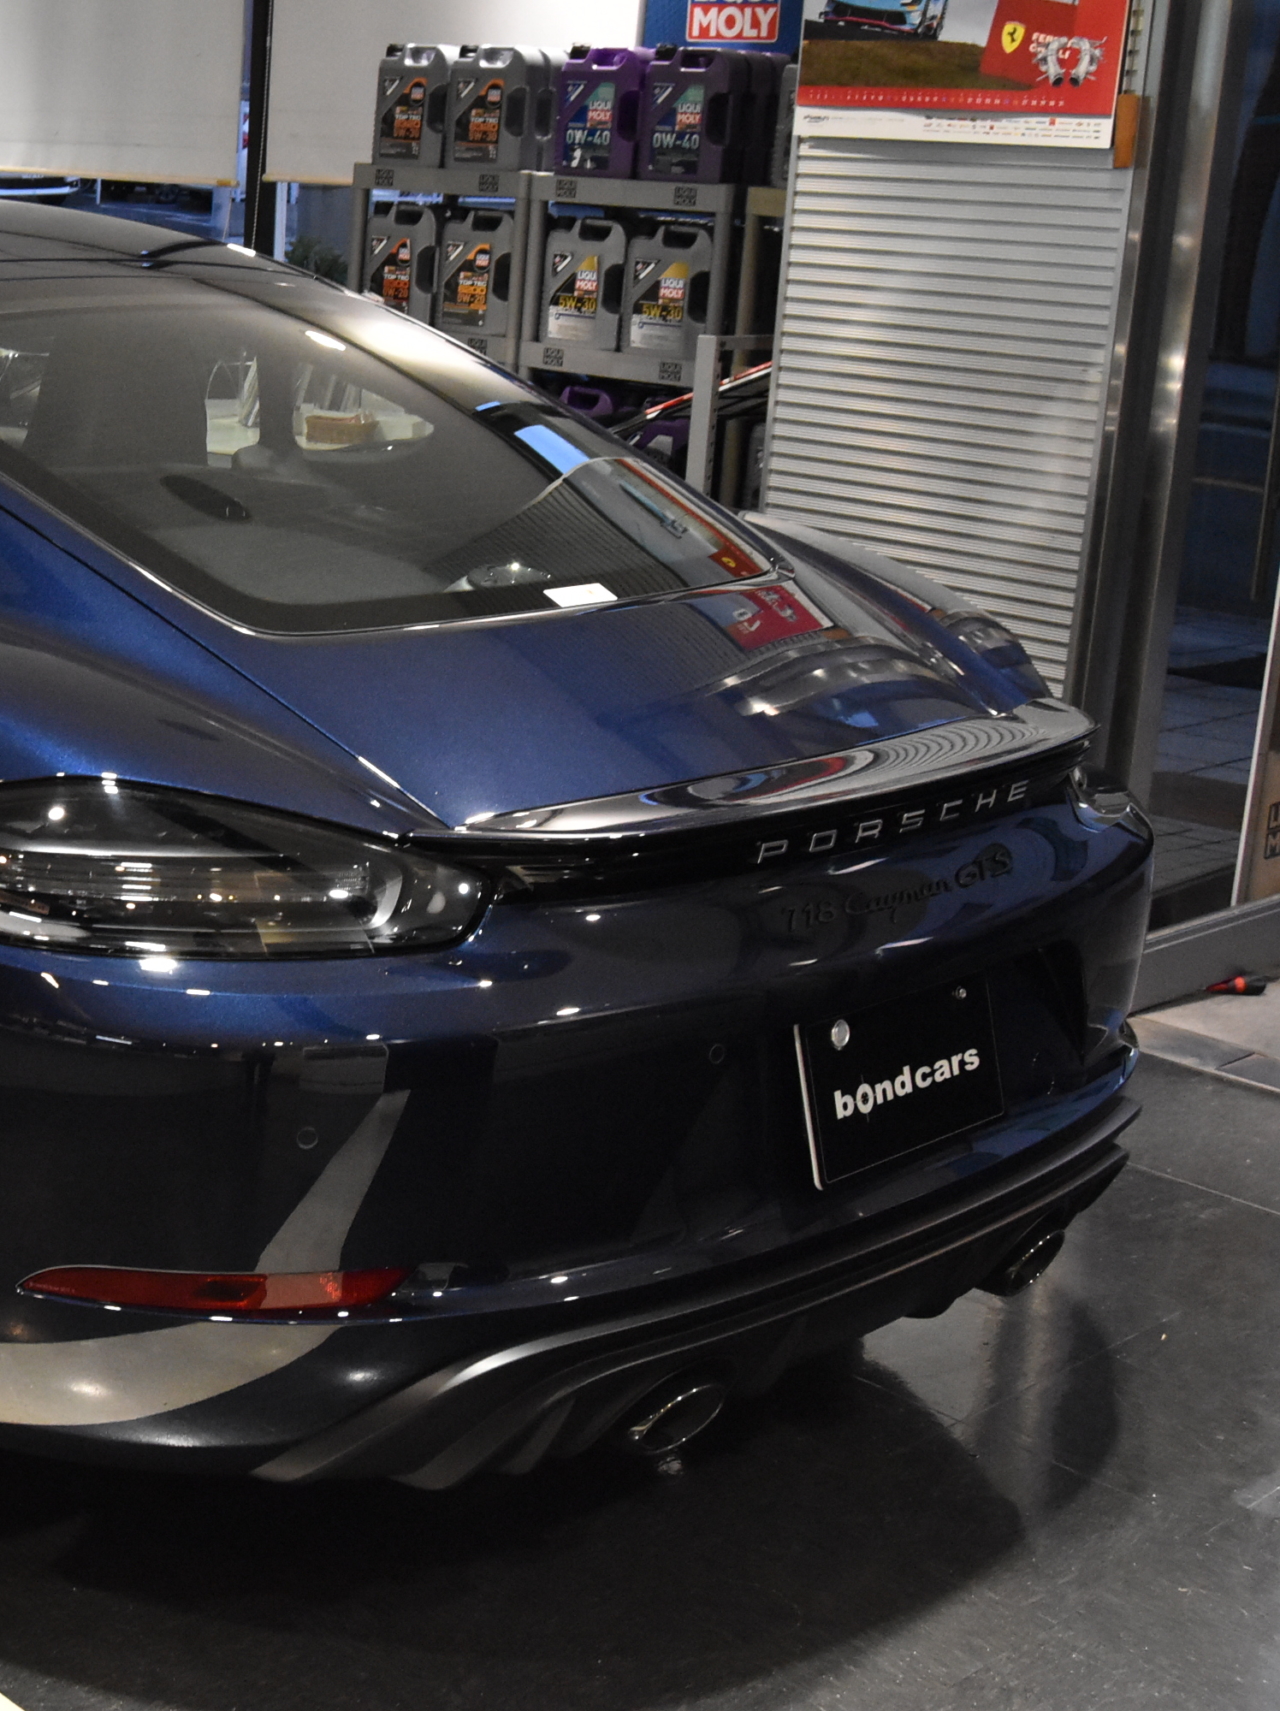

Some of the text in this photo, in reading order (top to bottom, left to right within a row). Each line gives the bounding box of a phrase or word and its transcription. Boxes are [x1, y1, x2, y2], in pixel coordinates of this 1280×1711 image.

[692, 6, 777, 38] MOLY
[589, 101, 612, 110] LIQUI
[678, 103, 701, 113] LIQUI
[588, 110, 612, 121] MOLY
[676, 113, 702, 123] MOLY
[566, 130, 611, 145] 0W-40
[652, 132, 700, 148] 0W-40
[577, 271, 597, 280] LIQUI
[575, 280, 598, 291] MOLY
[661, 278, 684, 288] LIQUI
[659, 288, 684, 299] MOLY
[559, 295, 597, 311] 5W-30
[642, 302, 683, 319] 5W-30
[757, 780, 1029, 864] PORSCHE
[780, 848, 1014, 934] 718 Cayman GTS
